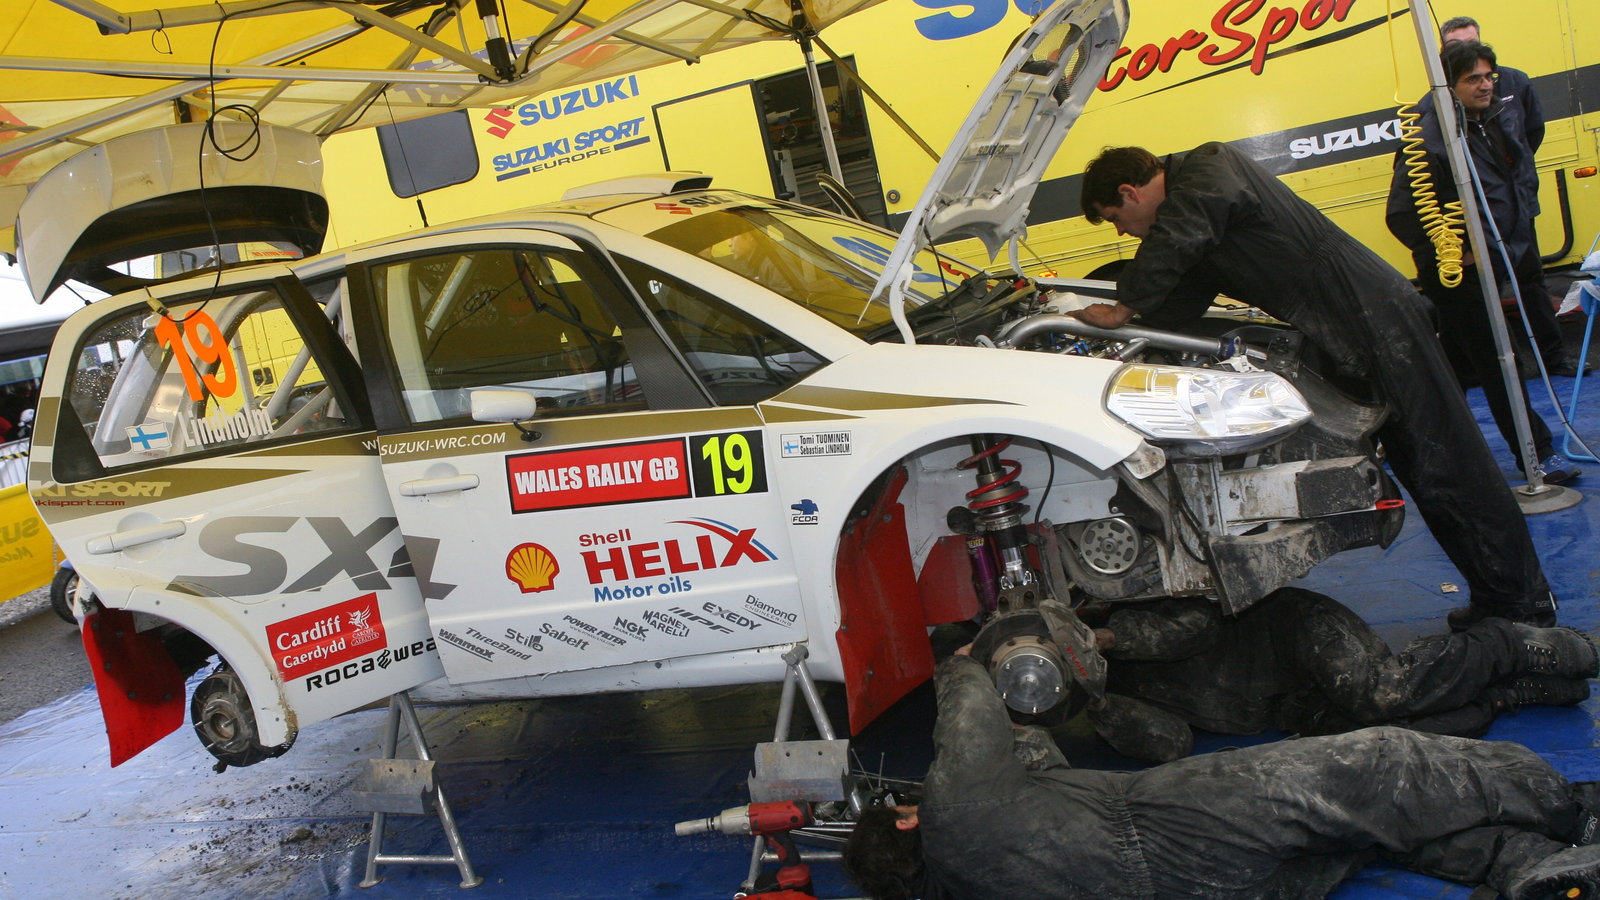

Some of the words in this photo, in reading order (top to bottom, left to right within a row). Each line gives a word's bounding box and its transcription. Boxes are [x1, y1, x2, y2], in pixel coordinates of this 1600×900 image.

[518, 75, 639, 126] SUZUKI
[493, 137, 570, 172] SUZUKI
[574, 117, 645, 151] SPORT
[1289, 118, 1404, 160] SUZUKI
[532, 146, 611, 173] EUROPE
[155, 310, 236, 402] 19
[178, 406, 274, 448] Lindholm
[800, 435, 814, 444] Tomi
[816, 433, 849, 444] TUOMINEN
[702, 433, 753, 494] 19
[800, 445, 825, 455] Sebastian
[826, 443, 850, 453] LINDHOLM
[72, 481, 171, 497] SPORT
[514, 465, 583, 495] WALES
[586, 459, 644, 488] RALLY
[650, 456, 679, 482] GB
[578, 528, 632, 547] Shell
[580, 528, 770, 584] HELIX
[593, 585, 653, 602] Motor
[658, 575, 692, 596] oils
[562, 615, 598, 633] POWER
[597, 630, 627, 645] FILTER
[614, 616, 649, 638] NGK
[642, 610, 690, 637] MAGNETI
[642, 613, 690, 638] MARELLI
[702, 602, 762, 631] EXEDY
[276, 615, 341, 650] Cardiff
[466, 627, 532, 660] ThreeBond
[539, 622, 591, 651] Sabelt
[283, 637, 346, 669] Caerdydd
